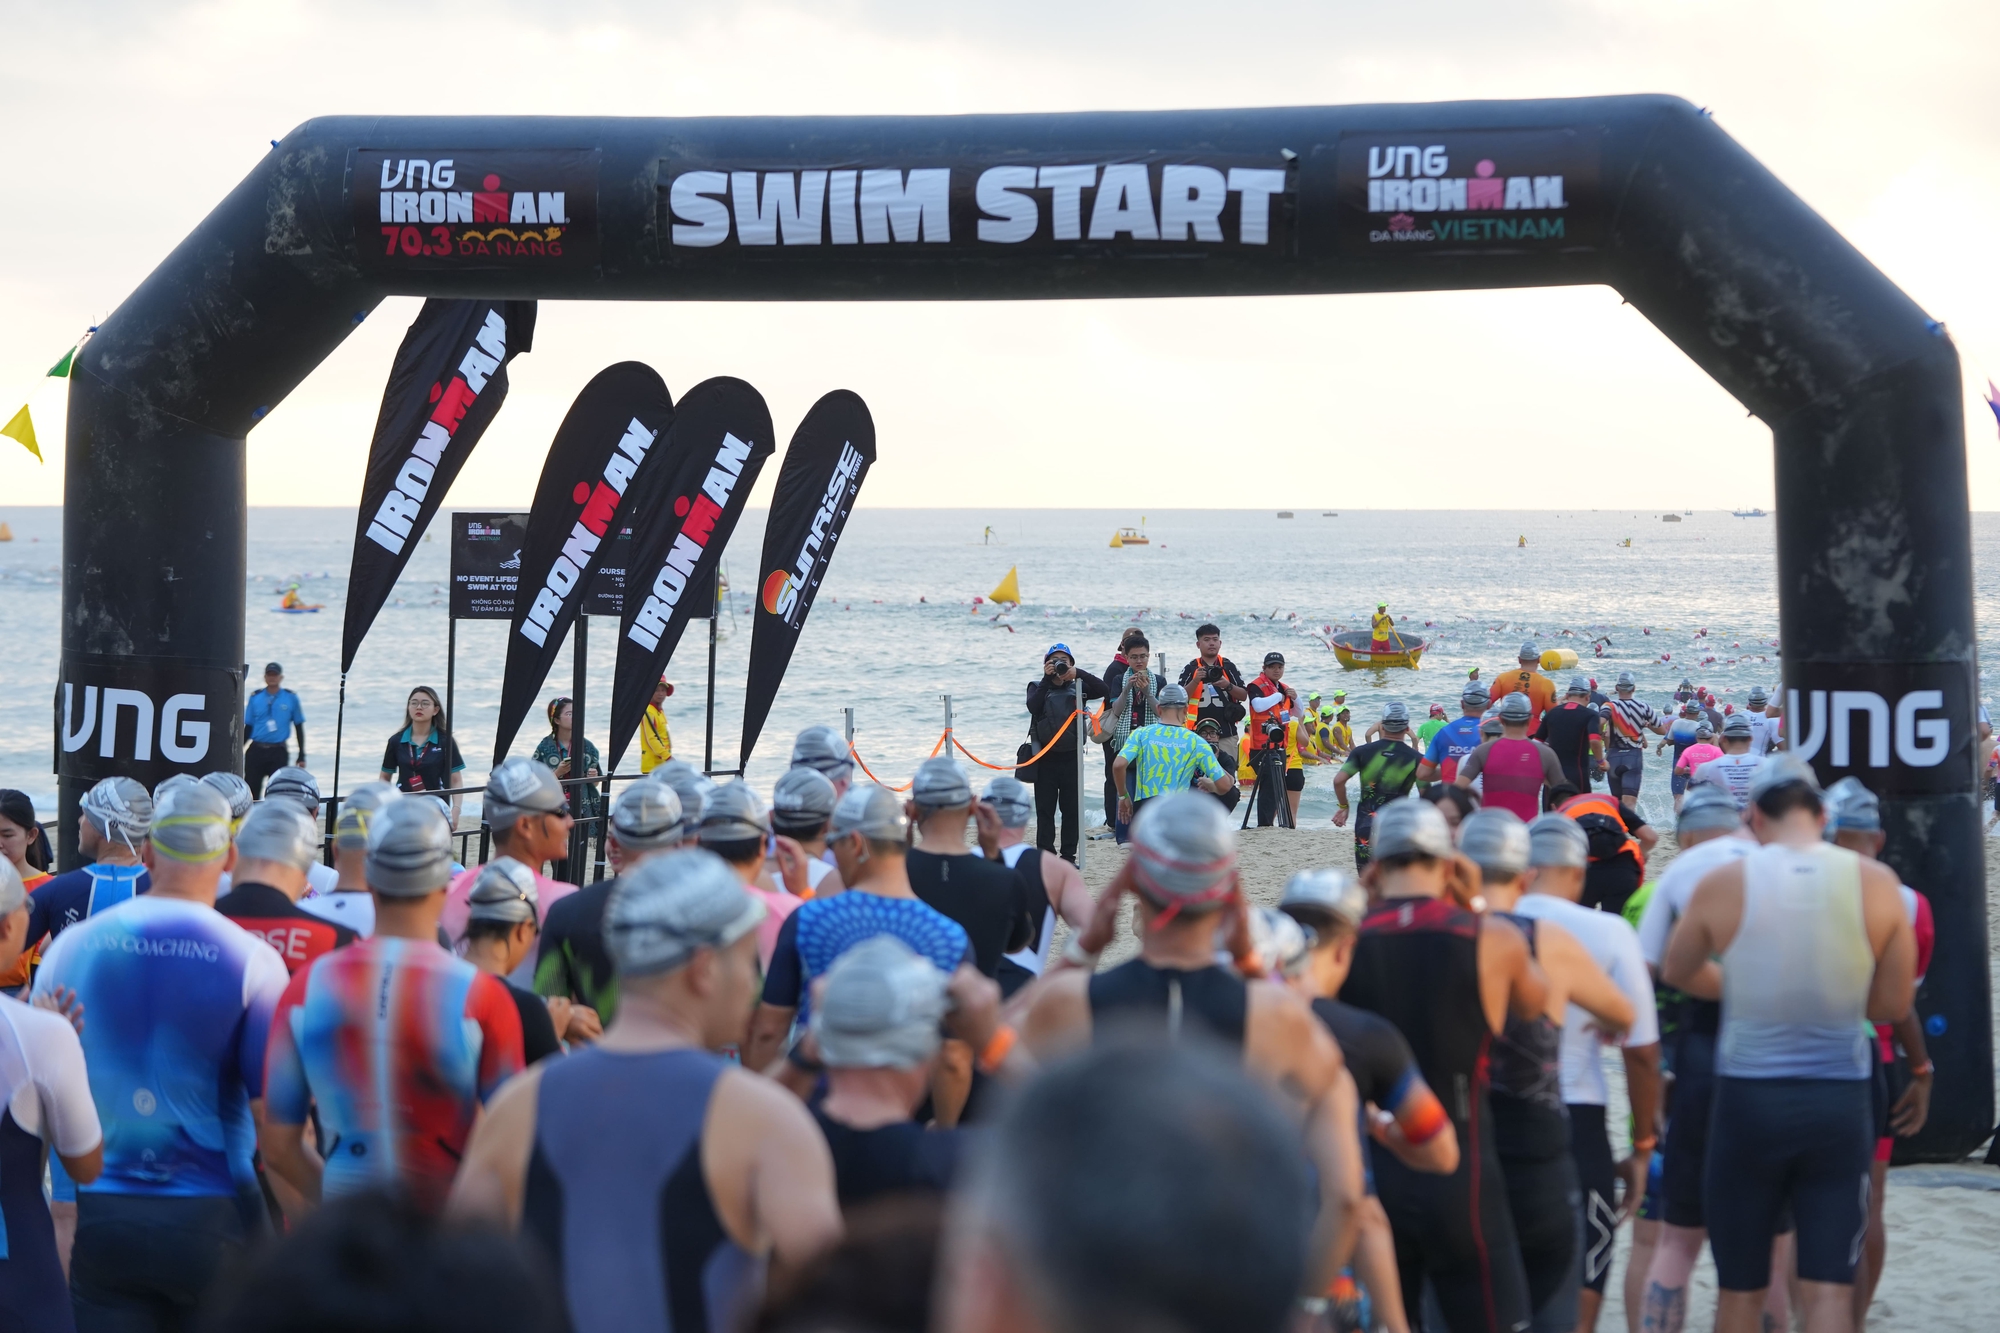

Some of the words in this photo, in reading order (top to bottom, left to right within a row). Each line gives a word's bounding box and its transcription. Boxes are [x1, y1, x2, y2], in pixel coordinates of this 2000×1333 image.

[380, 159, 456, 190] VNG
[1368, 145, 1448, 178] VNG
[380, 186, 566, 224] IRONMAN
[670, 168, 951, 248] SWIM
[976, 164, 1286, 245] START
[1368, 172, 1564, 213] IRONMAN
[381, 225, 453, 257] 70.3
[458, 240, 491, 256] DA
[497, 240, 563, 257] NANG
[1431, 217, 1566, 240] VIETNAM
[365, 308, 507, 556] IRONMAN
[849, 454, 864, 481] EVENTS
[519, 416, 656, 649] IRONMAN
[627, 431, 752, 653] IRONMAN
[63, 682, 211, 764] VNG
